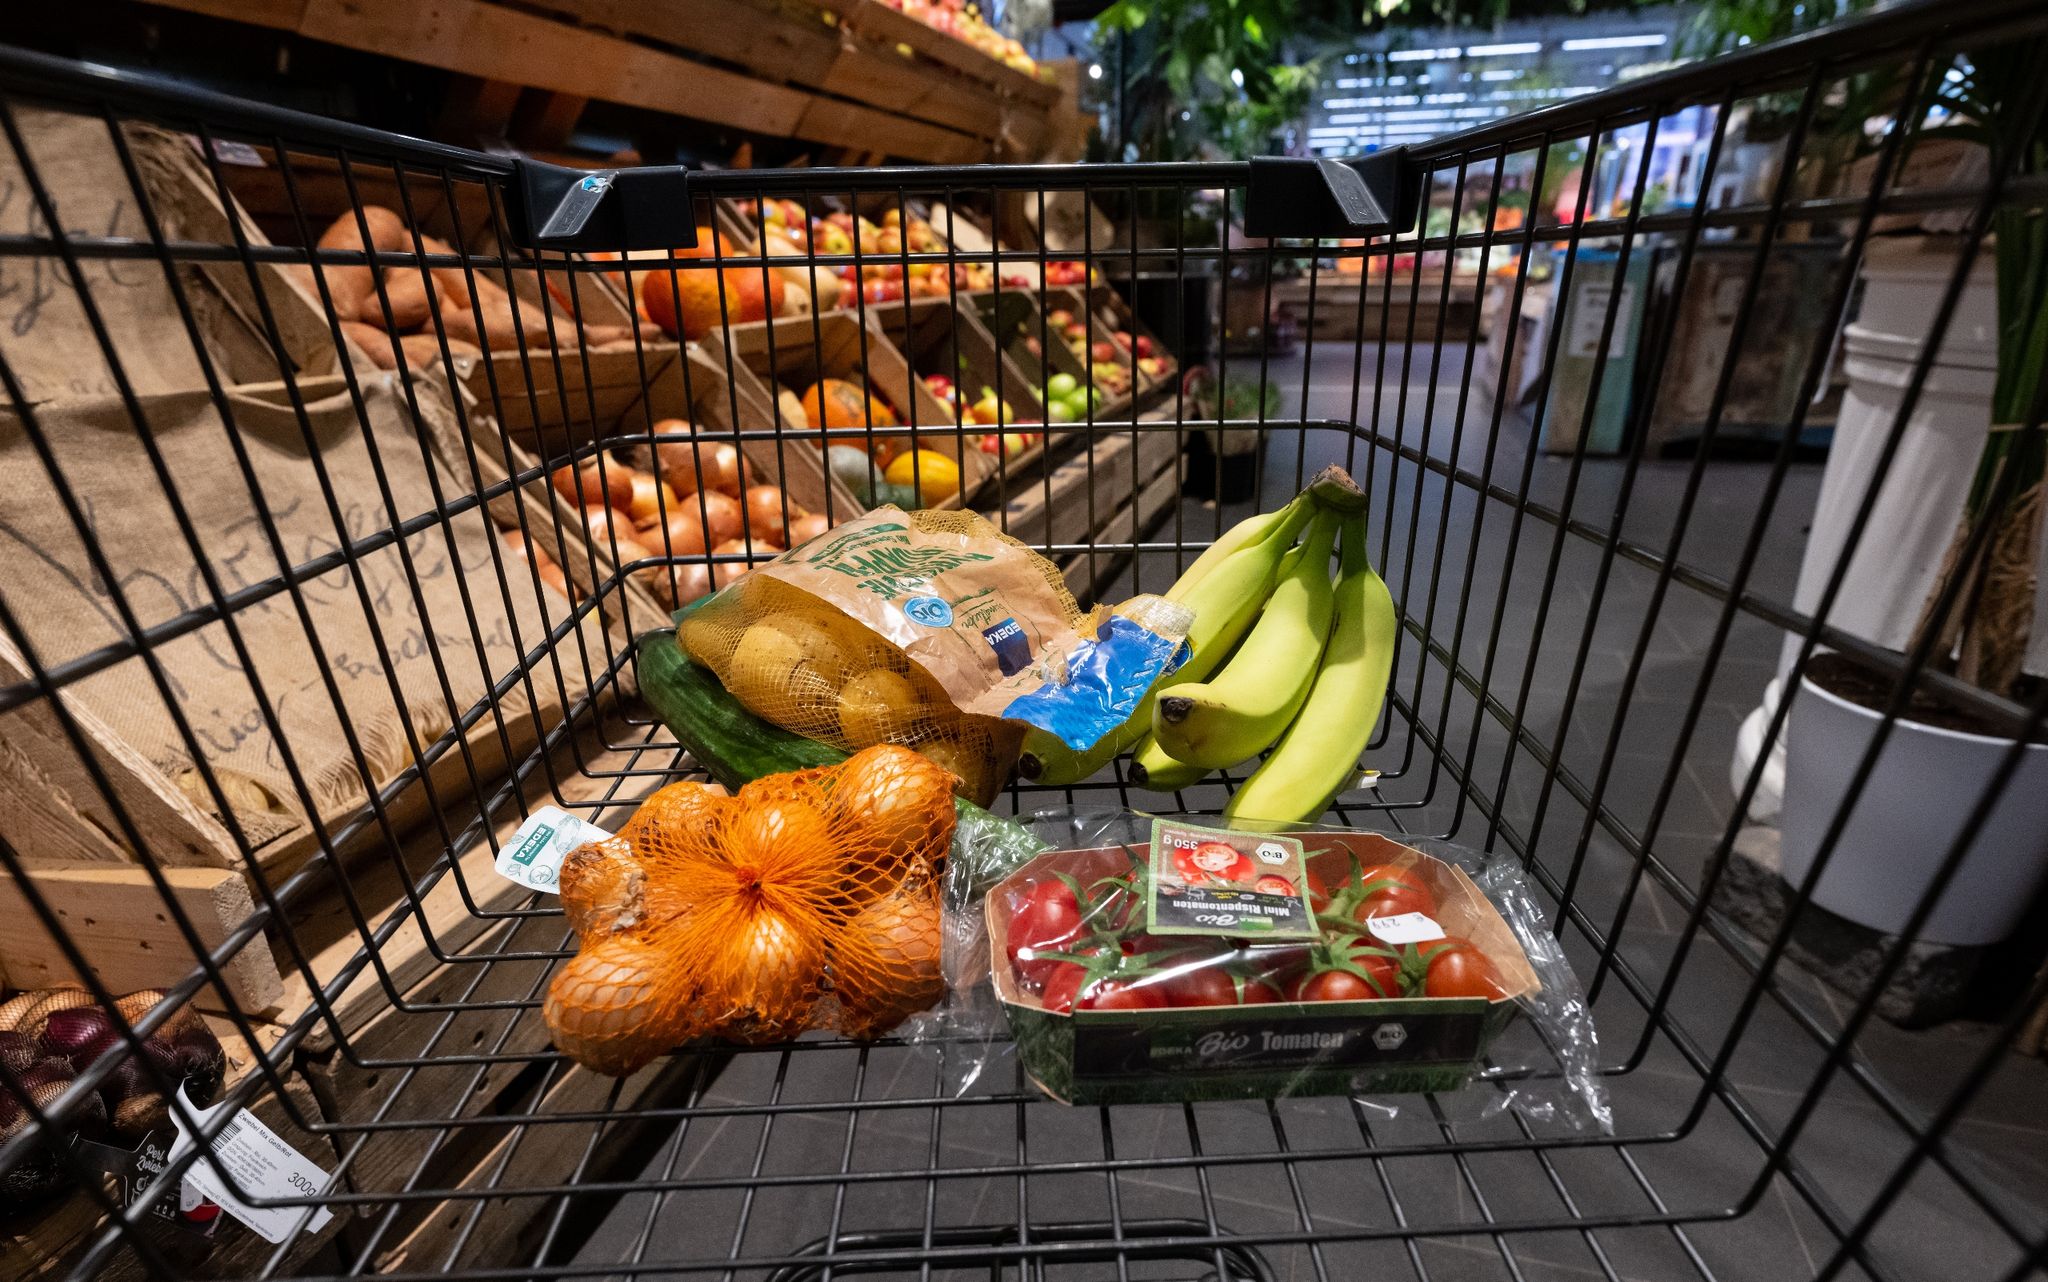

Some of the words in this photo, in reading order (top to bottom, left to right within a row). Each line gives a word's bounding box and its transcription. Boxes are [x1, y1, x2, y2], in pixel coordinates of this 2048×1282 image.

[984, 622, 1022, 646] EDEKA
[516, 827, 547, 858] EDEKA
[1163, 835, 1172, 844] g
[1174, 840, 1198, 850] 350
[1173, 900, 1261, 914] Rispentomaten
[1264, 905, 1290, 916] Mini
[1196, 914, 1239, 926] Bio
[1195, 1031, 1249, 1056] Bio
[1260, 1031, 1344, 1051] Tomaten
[238, 1113, 261, 1132] Zwiebel
[259, 1129, 269, 1140] Mix
[146, 1143, 166, 1160] Perl
[287, 1172, 317, 1198] 300g
